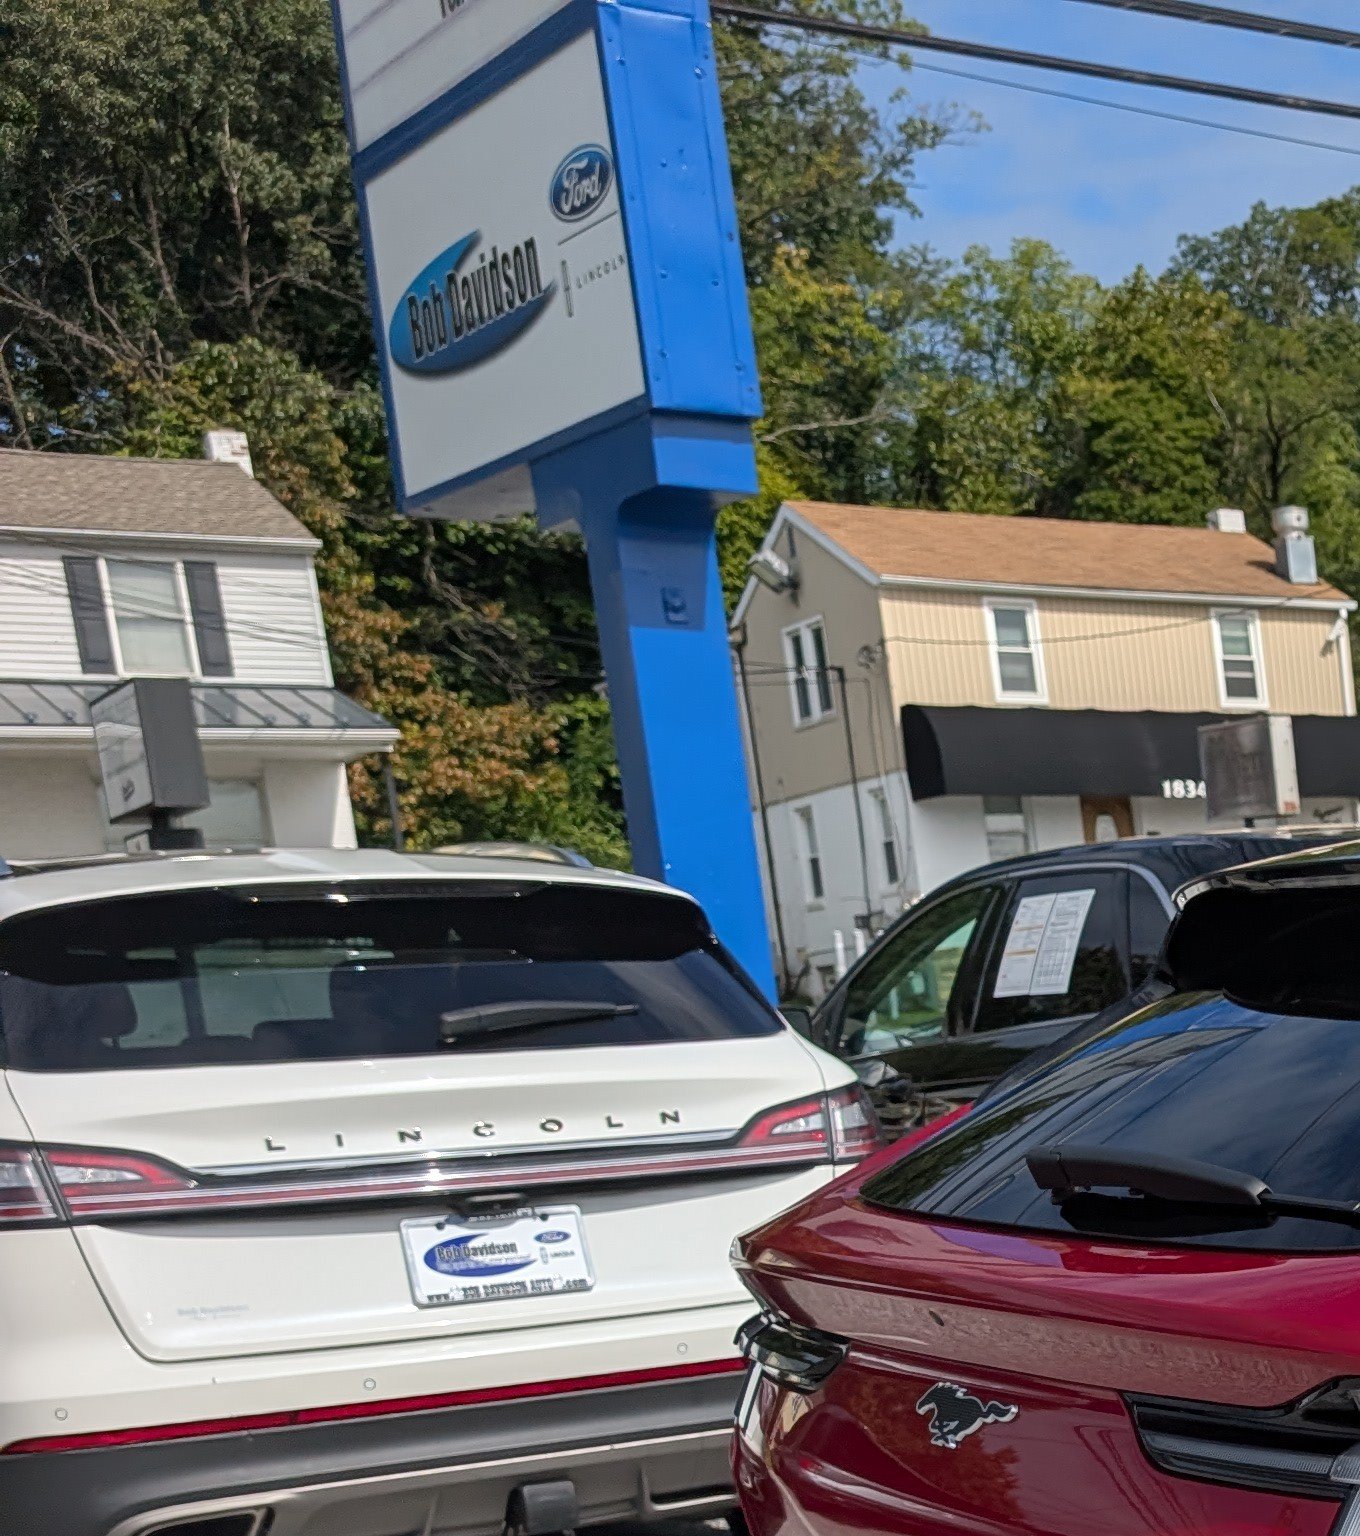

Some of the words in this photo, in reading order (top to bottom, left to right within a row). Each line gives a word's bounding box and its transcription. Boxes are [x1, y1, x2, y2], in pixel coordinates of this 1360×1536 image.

[560, 157, 601, 213] Ford
[575, 253, 626, 290] LINCOLN
[407, 281, 448, 360] Bob
[446, 235, 543, 340] Davidson
[1161, 778, 1207, 799] 1834
[263, 1108, 681, 1153] LINCOLN
[436, 1244, 461, 1261] Bob
[462, 1241, 519, 1257] Davidson
